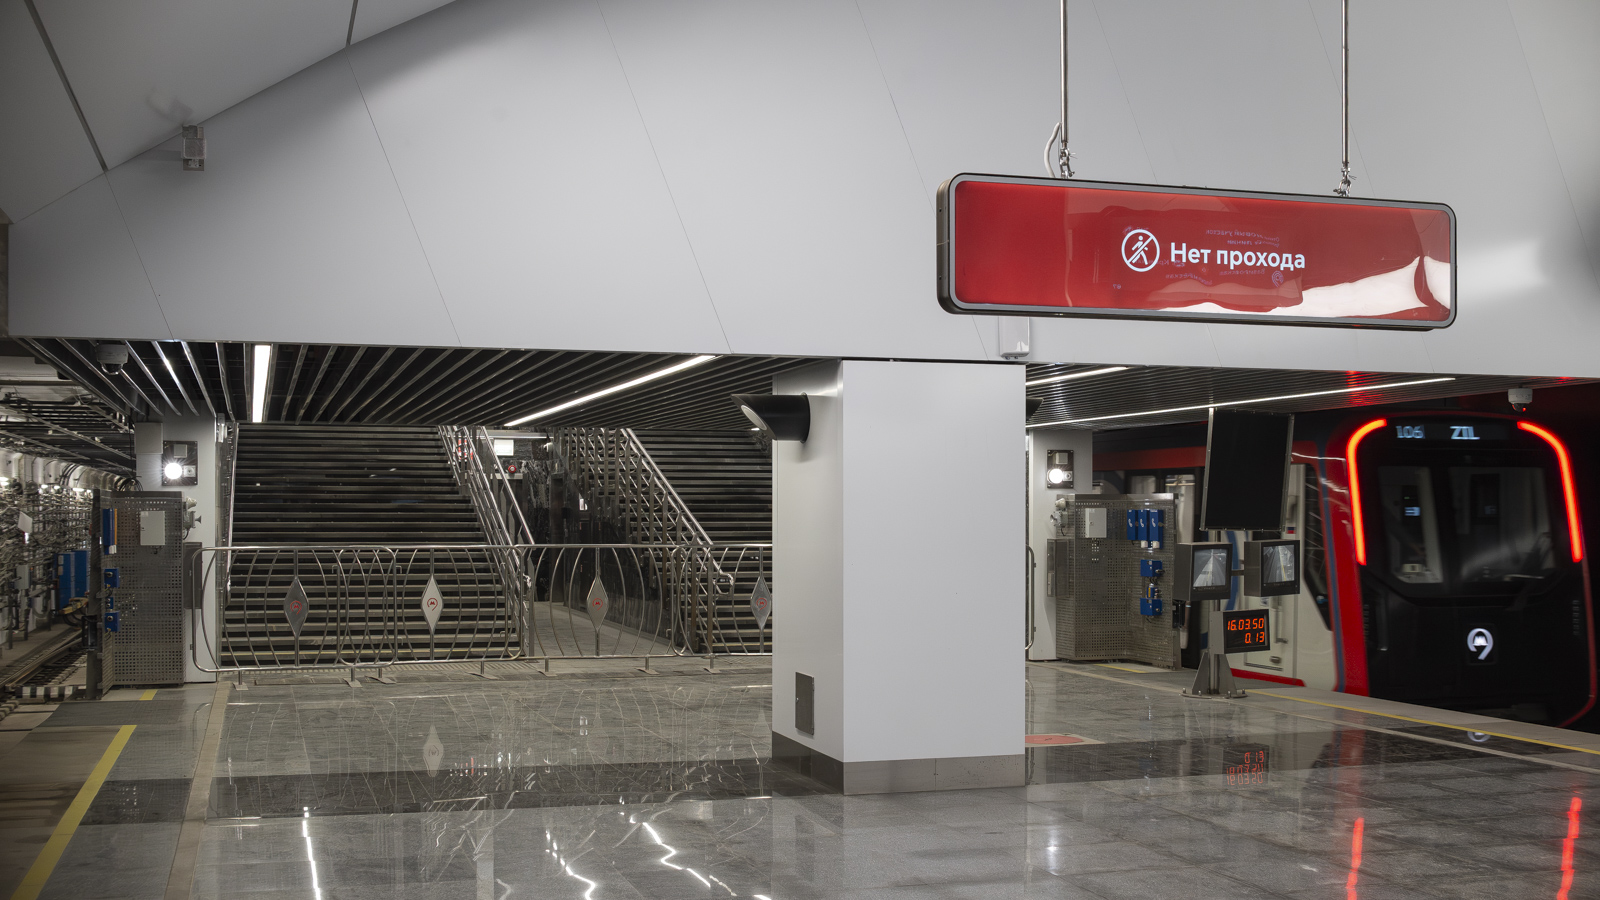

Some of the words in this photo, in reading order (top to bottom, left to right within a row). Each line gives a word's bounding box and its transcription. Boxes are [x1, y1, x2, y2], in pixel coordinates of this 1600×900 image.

[1171, 242, 1211, 263] Нет
[1217, 250, 1305, 271] прохода
[1395, 425, 1424, 439] 106
[1449, 425, 1480, 440] ZIL
[1227, 617, 1265, 631] 16.03.50
